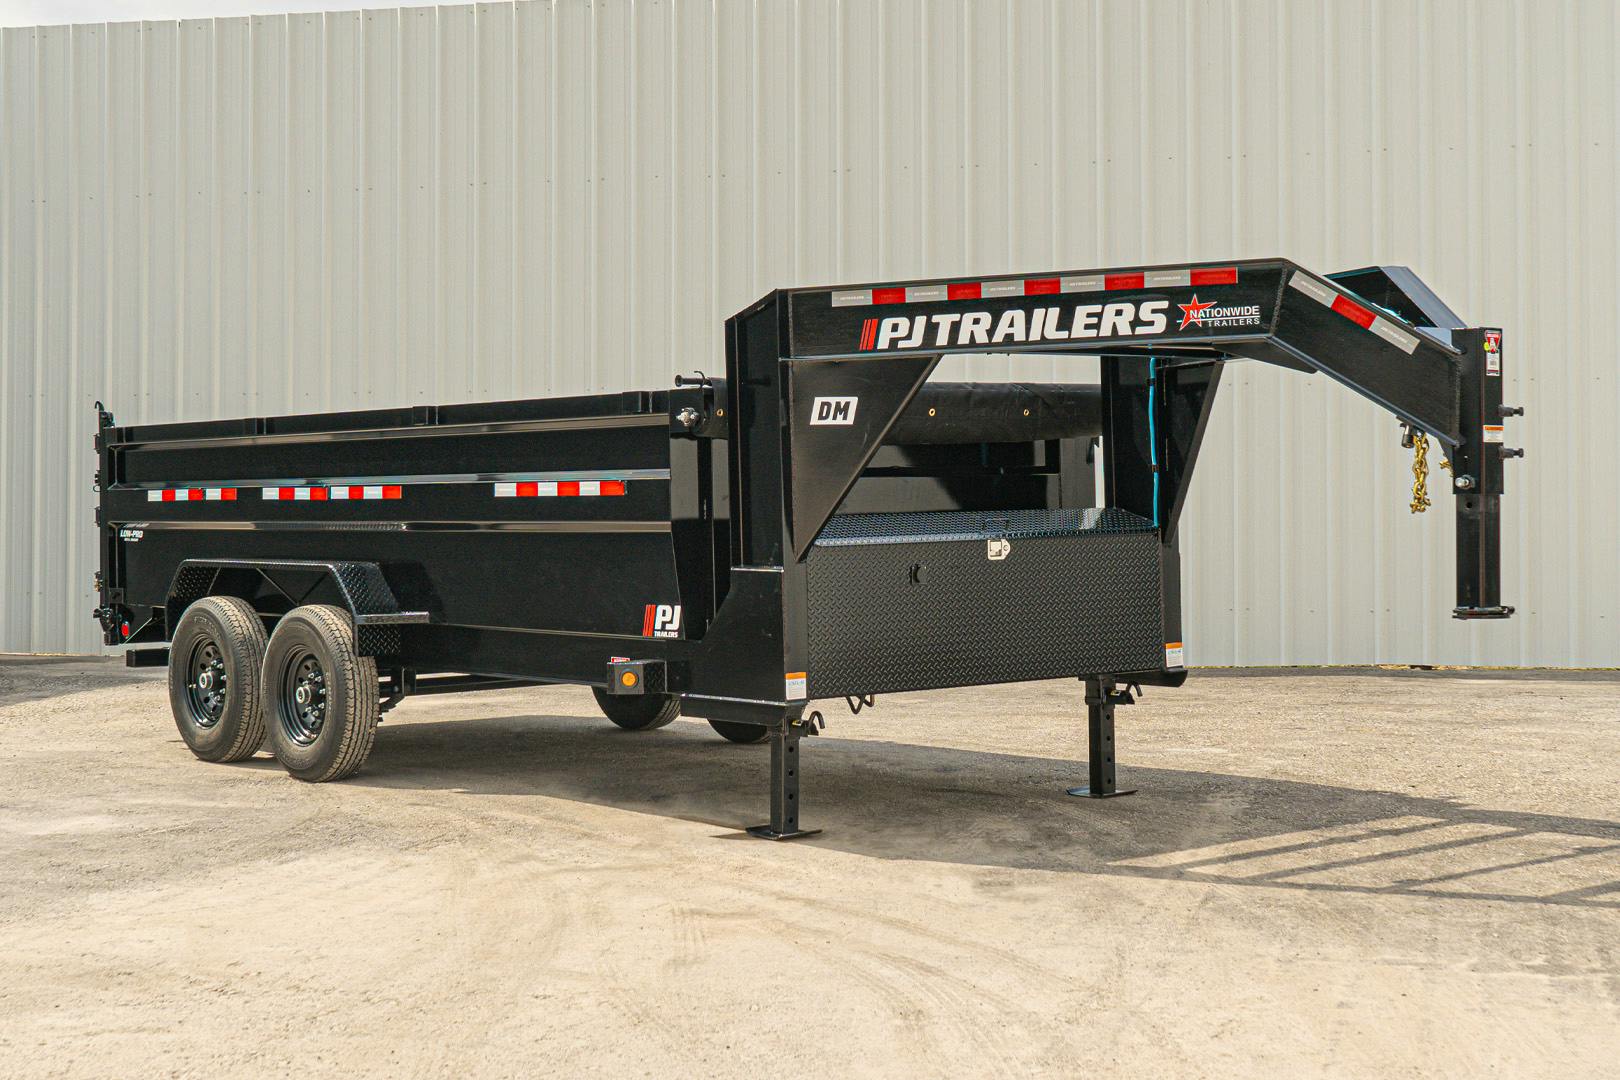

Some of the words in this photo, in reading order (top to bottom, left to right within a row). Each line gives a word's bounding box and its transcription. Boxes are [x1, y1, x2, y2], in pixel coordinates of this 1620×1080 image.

[1189, 305, 1260, 319] NATIONWIDE
[877, 316, 926, 349] PJ
[932, 301, 1169, 346] TRAILERS
[1207, 318, 1260, 327] TRAILERS
[818, 401, 851, 421] DM
[655, 605, 682, 630] PJ
